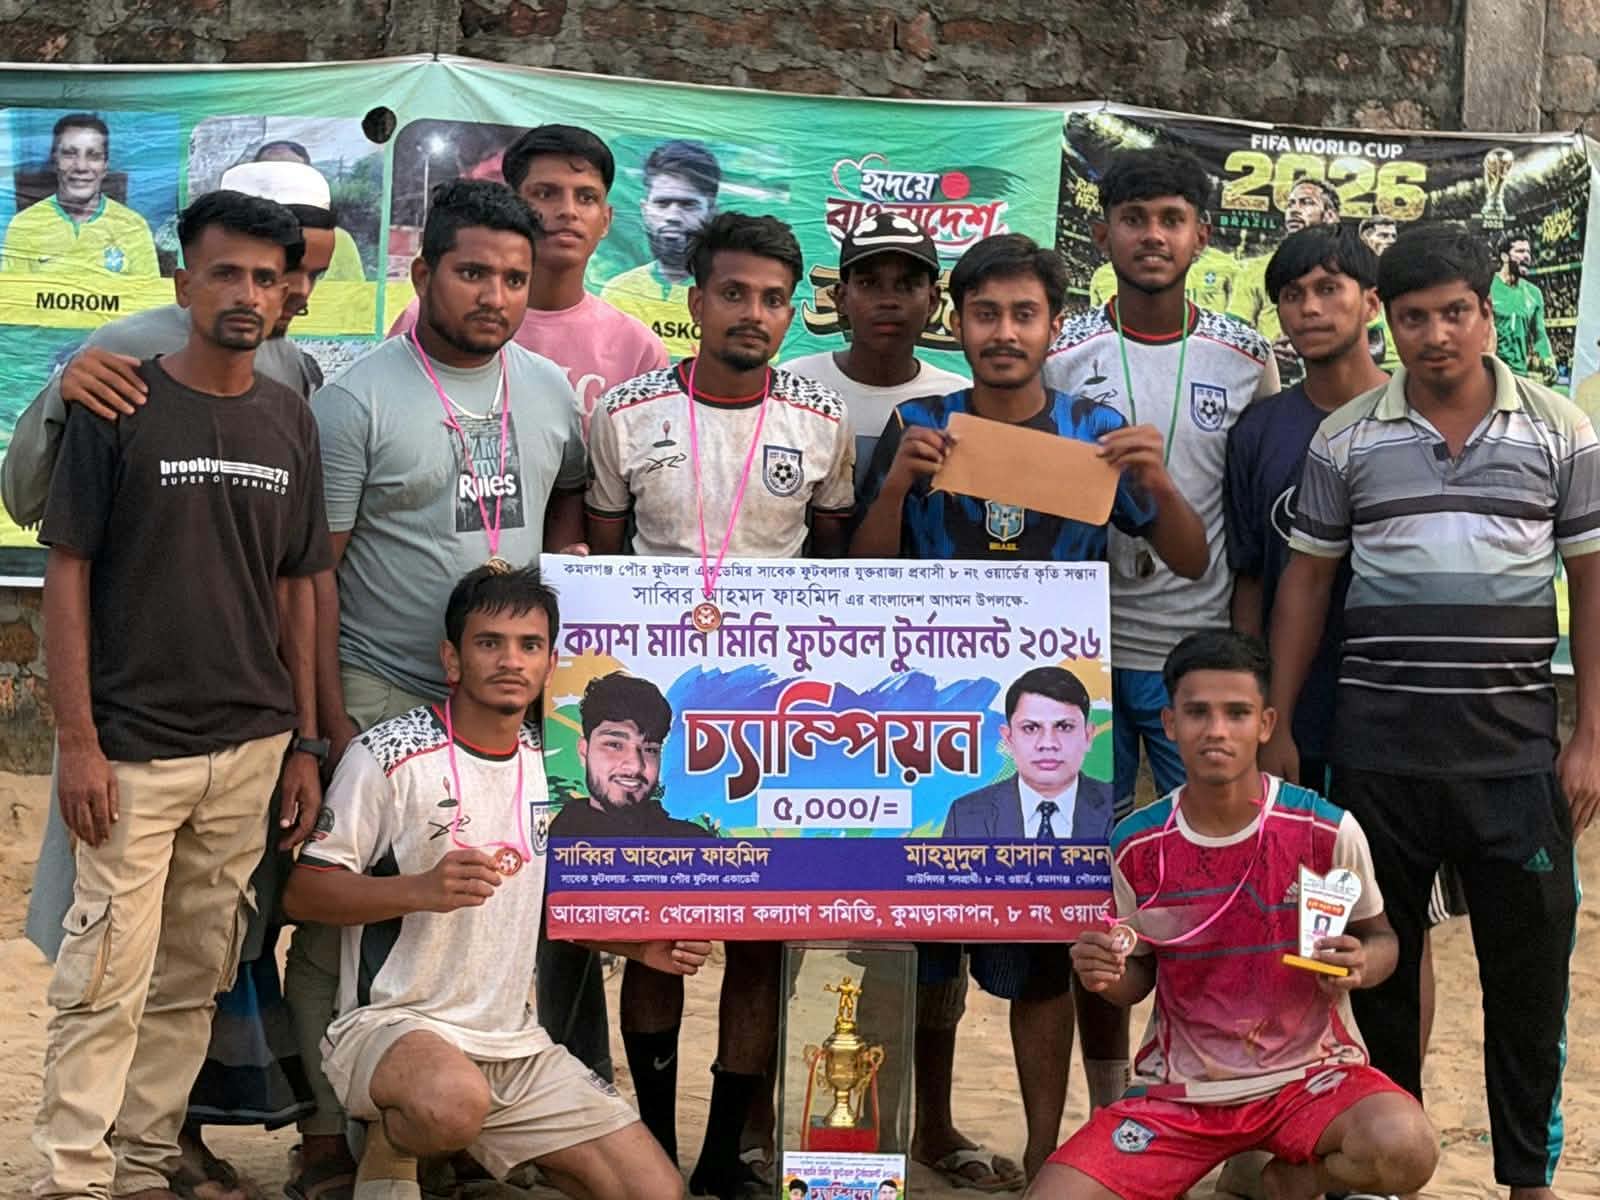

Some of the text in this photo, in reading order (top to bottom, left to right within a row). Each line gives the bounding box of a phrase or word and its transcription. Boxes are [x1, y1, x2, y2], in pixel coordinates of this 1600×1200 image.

[1251, 134, 1403, 158] FIFA WORLD CUP
[1221, 151, 1427, 221] 2026
[36, 292, 119, 312] MOROM
[651, 320, 702, 340] ASKO
[563, 563, 613, 577] কমলগঞ্জ
[619, 563, 647, 577] পৌর
[652, 564, 689, 579] ফুটবল
[757, 565, 796, 577] সাবেক
[801, 564, 850, 581] ফুটবলার
[854, 566, 904, 582] যুক্তরাজ্য
[908, 563, 945, 580] প্রবাসী
[949, 569, 959, 580] ৮
[963, 569, 980, 580] নং
[984, 564, 1029, 580] ওয়ার্ডের
[1034, 566, 1060, 584] কৃতি
[632, 581, 695, 606] সাব্বির
[772, 582, 841, 607] ফাহমিদ
[845, 594, 864, 607] এর
[869, 593, 925, 608] বাংলাদেশ
[930, 594, 971, 607] আগমন
[563, 611, 1101, 671] ক্যাশ মানি মিনি ফুটবল টুর্নামেন্ট ২০২৬
[682, 680, 984, 803] চ্যাম্পিয়ন
[773, 796, 899, 825] ৫,০০০/=
[554, 841, 772, 868] সাব্বির আহমেদ ফাহমিদ
[903, 843, 989, 872] মাহমুদুল
[993, 843, 1056, 868] হাসান
[550, 904, 650, 925] আয়োজনে:
[752, 904, 812, 924] কল্যাণ
[818, 898, 883, 927] সমিতি,
[1007, 907, 1022, 922] ৮
[1029, 904, 1053, 924] নং
